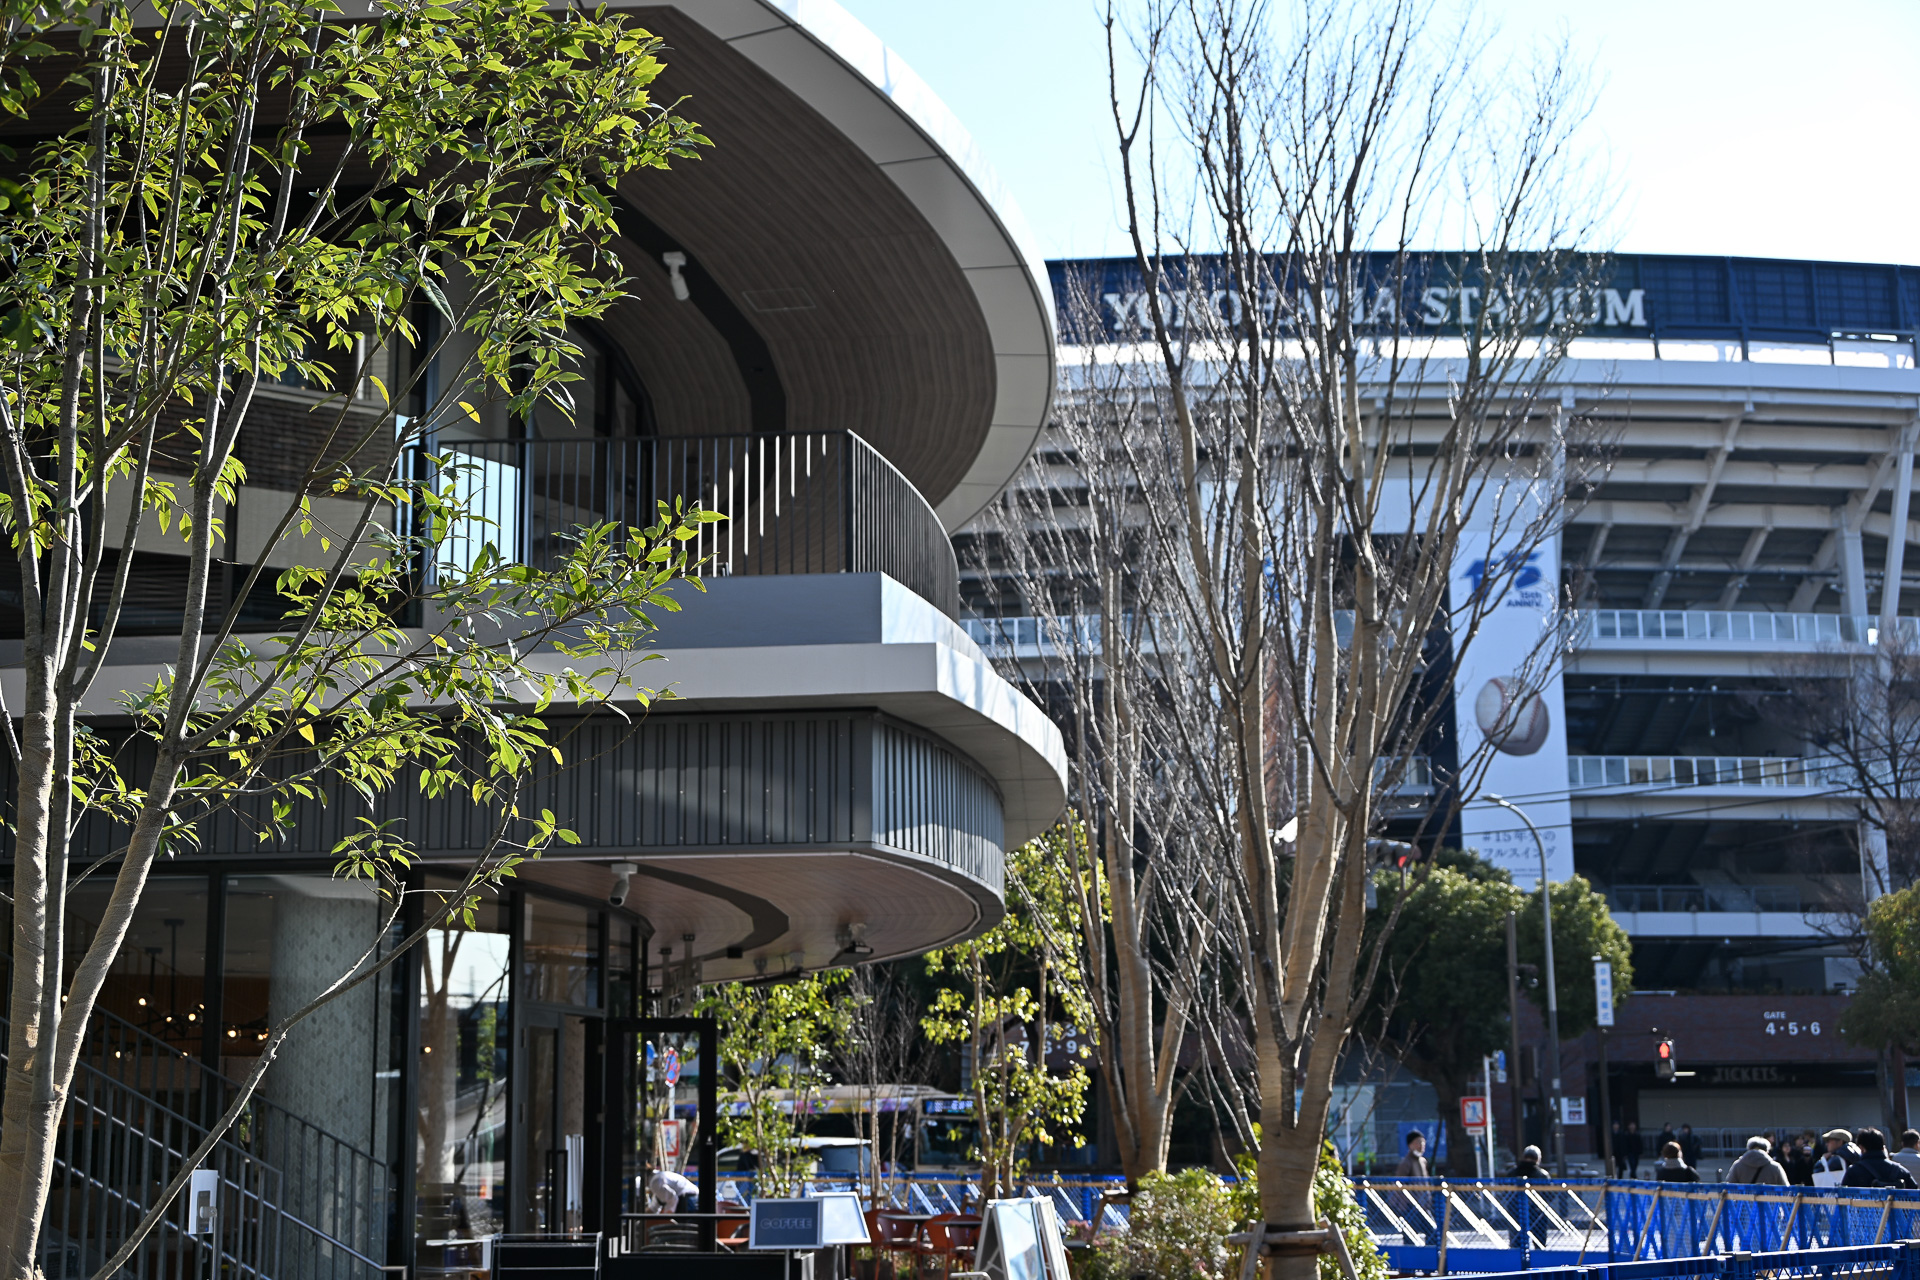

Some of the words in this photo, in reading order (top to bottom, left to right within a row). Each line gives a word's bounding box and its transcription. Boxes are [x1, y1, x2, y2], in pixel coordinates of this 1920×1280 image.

[1420, 286, 1648, 327] STADIUM
[1763, 1011, 1786, 1020] GATE
[1714, 1066, 1778, 1082] TICKETS
[760, 1217, 813, 1229] COFFEE
